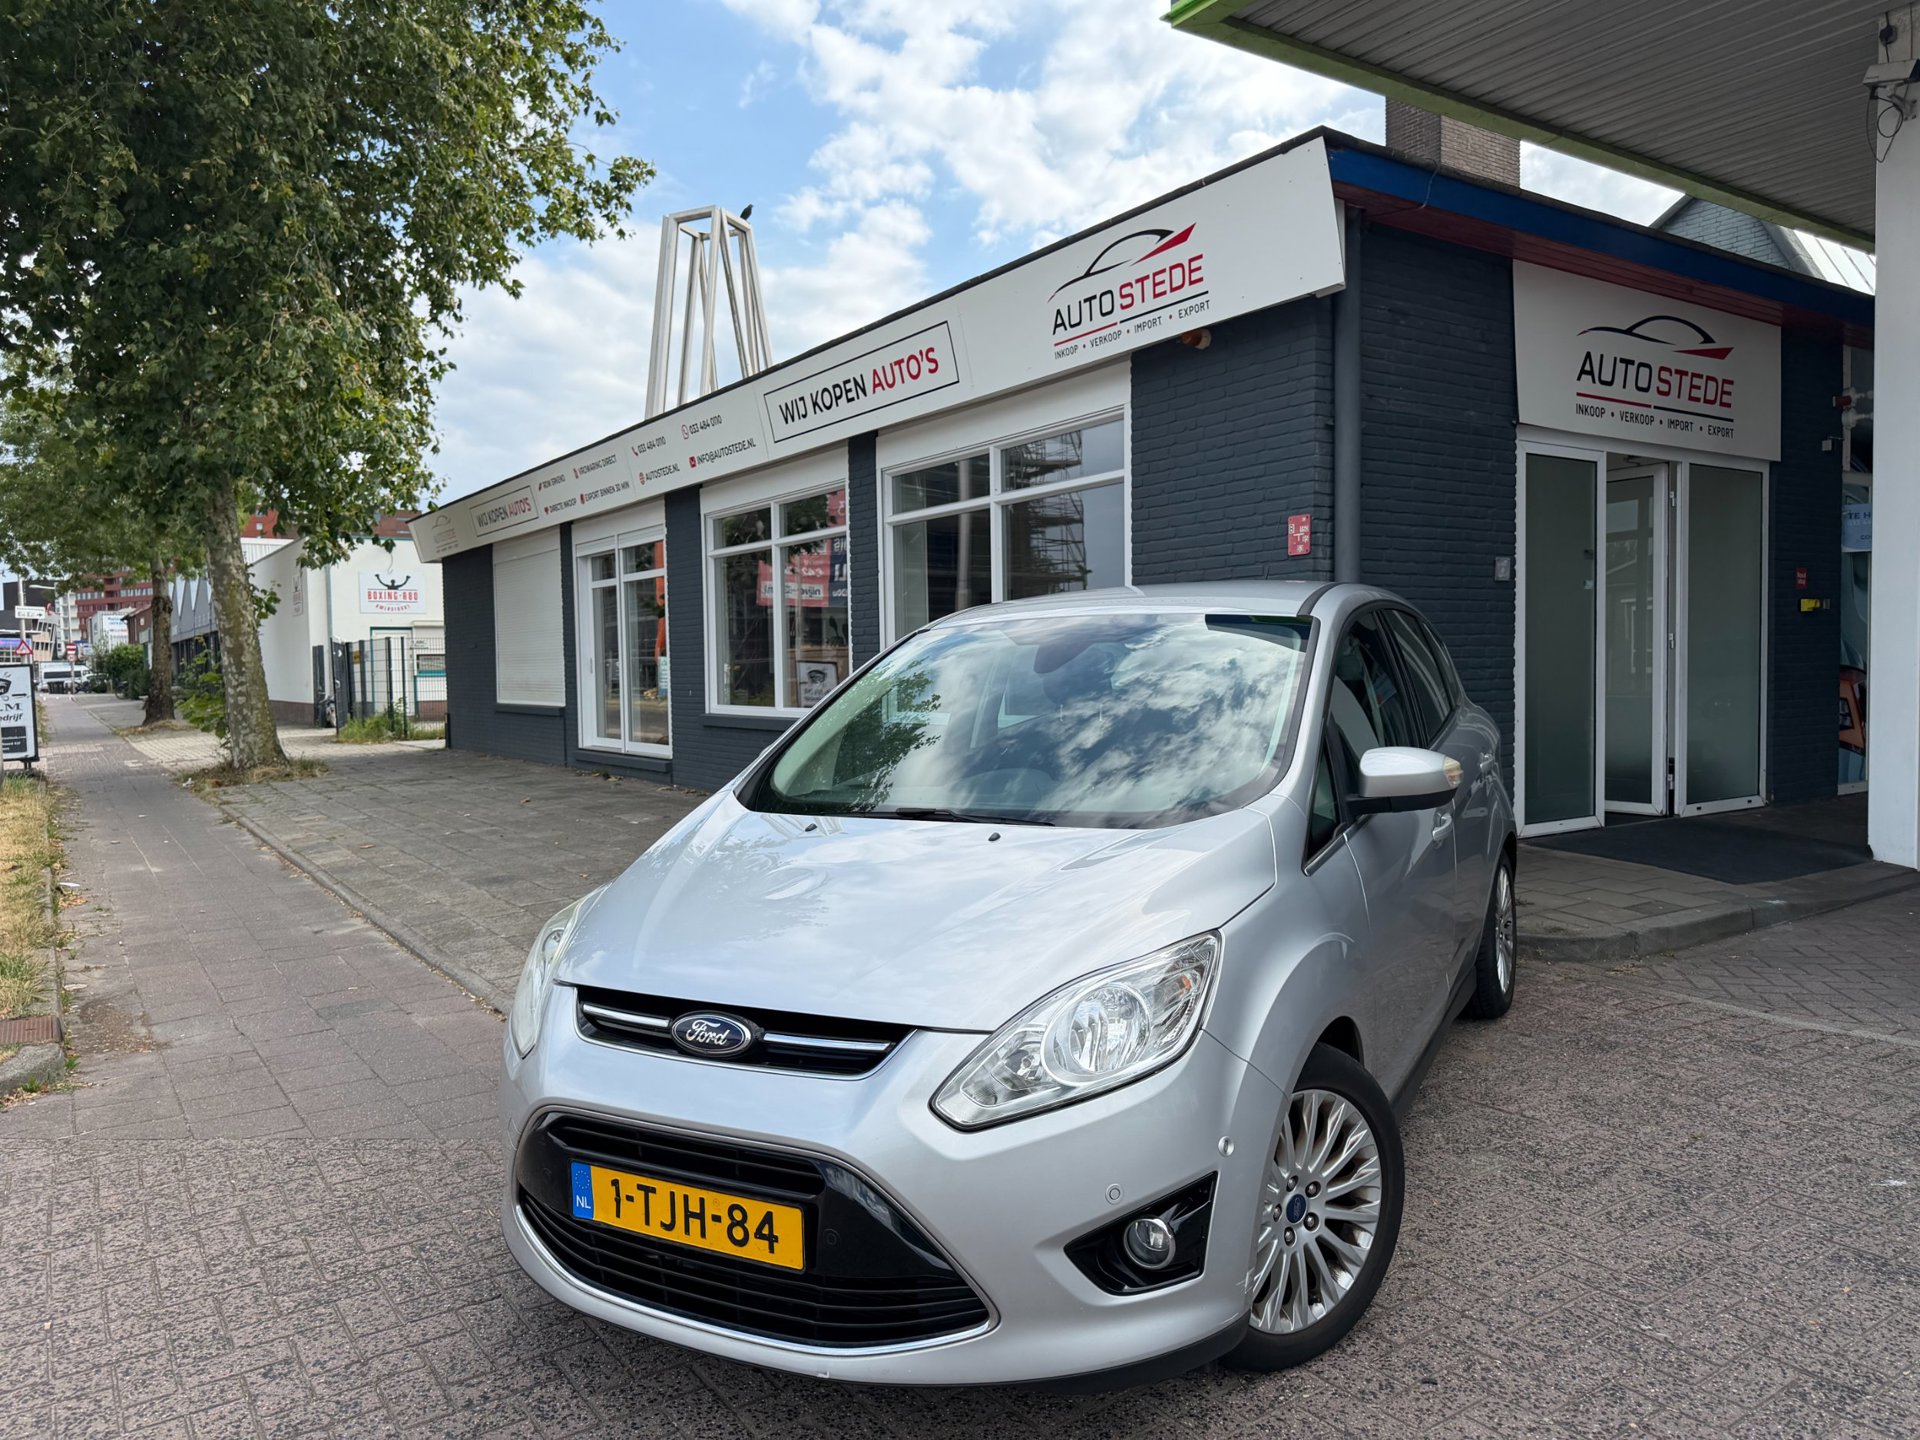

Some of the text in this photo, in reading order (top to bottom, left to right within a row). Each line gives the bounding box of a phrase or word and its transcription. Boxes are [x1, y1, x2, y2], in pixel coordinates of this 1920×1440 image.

[1054, 299, 1211, 360] INKOOP VERKOOP IMPORT EXPORT
[779, 346, 940, 425] WIJ KOPEN AUTO'S
[689, 423, 699, 435] 033
[1575, 403, 1735, 440] INKOOP VERKOOP IMPORT EXPORT
[696, 437, 757, 465] INFO@AUTOSTEDE.NL
[645, 463, 681, 481] AUTOSTEDE.NL
[477, 497, 532, 528] WIJ KOPEN AUTO'S
[686, 1020, 730, 1047] Ford
[576, 1178, 779, 1254] NL 1-TJH-84
